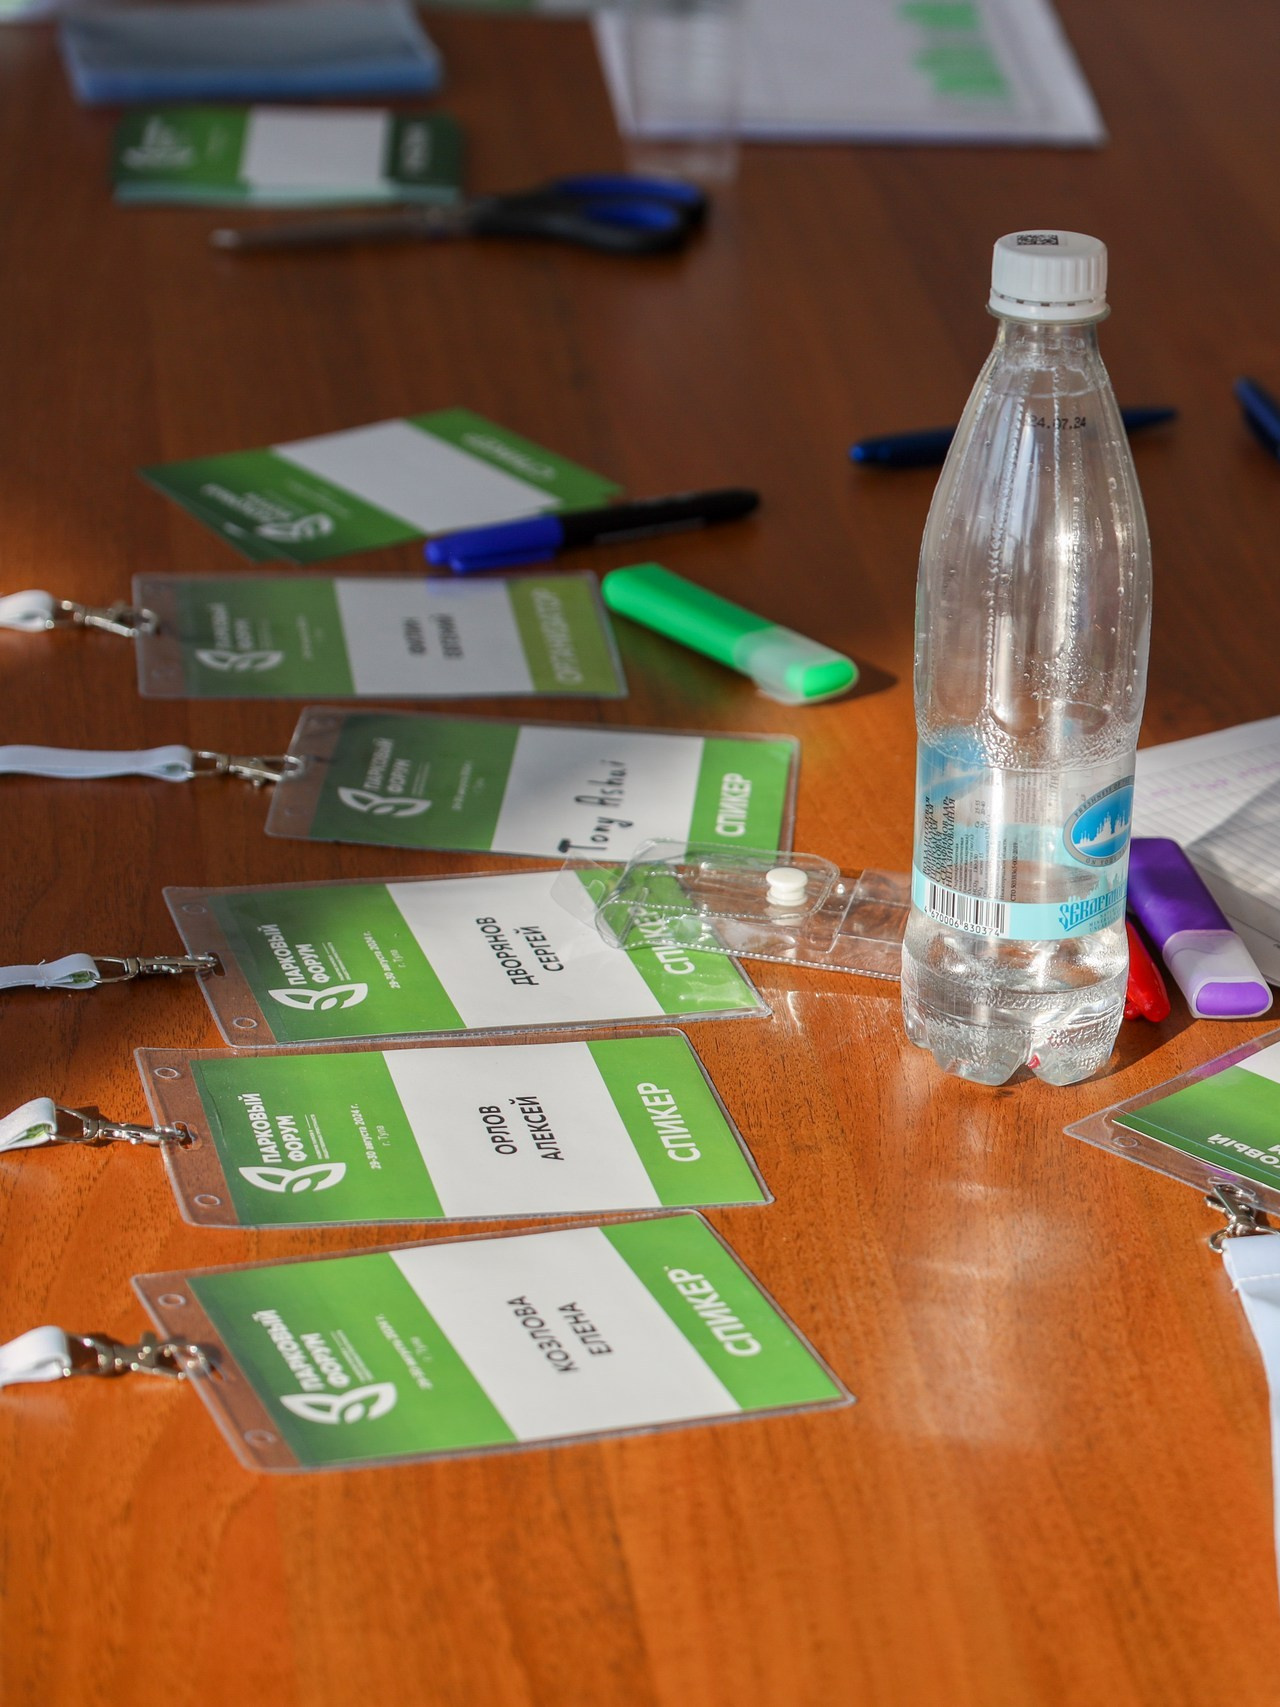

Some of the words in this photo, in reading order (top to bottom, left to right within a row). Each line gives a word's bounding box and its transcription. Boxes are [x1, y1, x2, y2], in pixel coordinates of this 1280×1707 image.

[362, 737, 394, 791] ПАРКОВЫЙ
[387, 758, 411, 793] ФОРУМ
[715, 772, 752, 837] СПИКЕР
[557, 816, 634, 853] Tony
[513, 925, 564, 972] СЕРГЕЙ
[931, 910, 960, 929] 670006
[963, 923, 1000, 937] 830374
[258, 924, 308, 986] ПАРКОВЫЙ
[295, 943, 331, 984] ФОРУМ
[476, 916, 539, 986] ДВОРЯНОВ
[237, 1093, 282, 1163] ПАРКОВЫЙ
[275, 1115, 307, 1162] ФОРУМ
[350, 1108, 365, 1126] 2024
[358, 1126, 375, 1151] августа
[376, 1125, 389, 1141] Тула
[478, 1105, 518, 1155] ОРЛОВ
[508, 1095, 565, 1161] АЛЕКСЕЙ
[636, 1082, 702, 1162] СПИКЕР
[507, 1295, 580, 1374] КОЗЛОВА
[558, 1301, 614, 1357] ЕЛЕНА
[667, 1268, 762, 1357] СПИКЕР
[252, 1309, 325, 1392] ПАРКОВЫЙ
[300, 1333, 350, 1388] ФОРУМ
